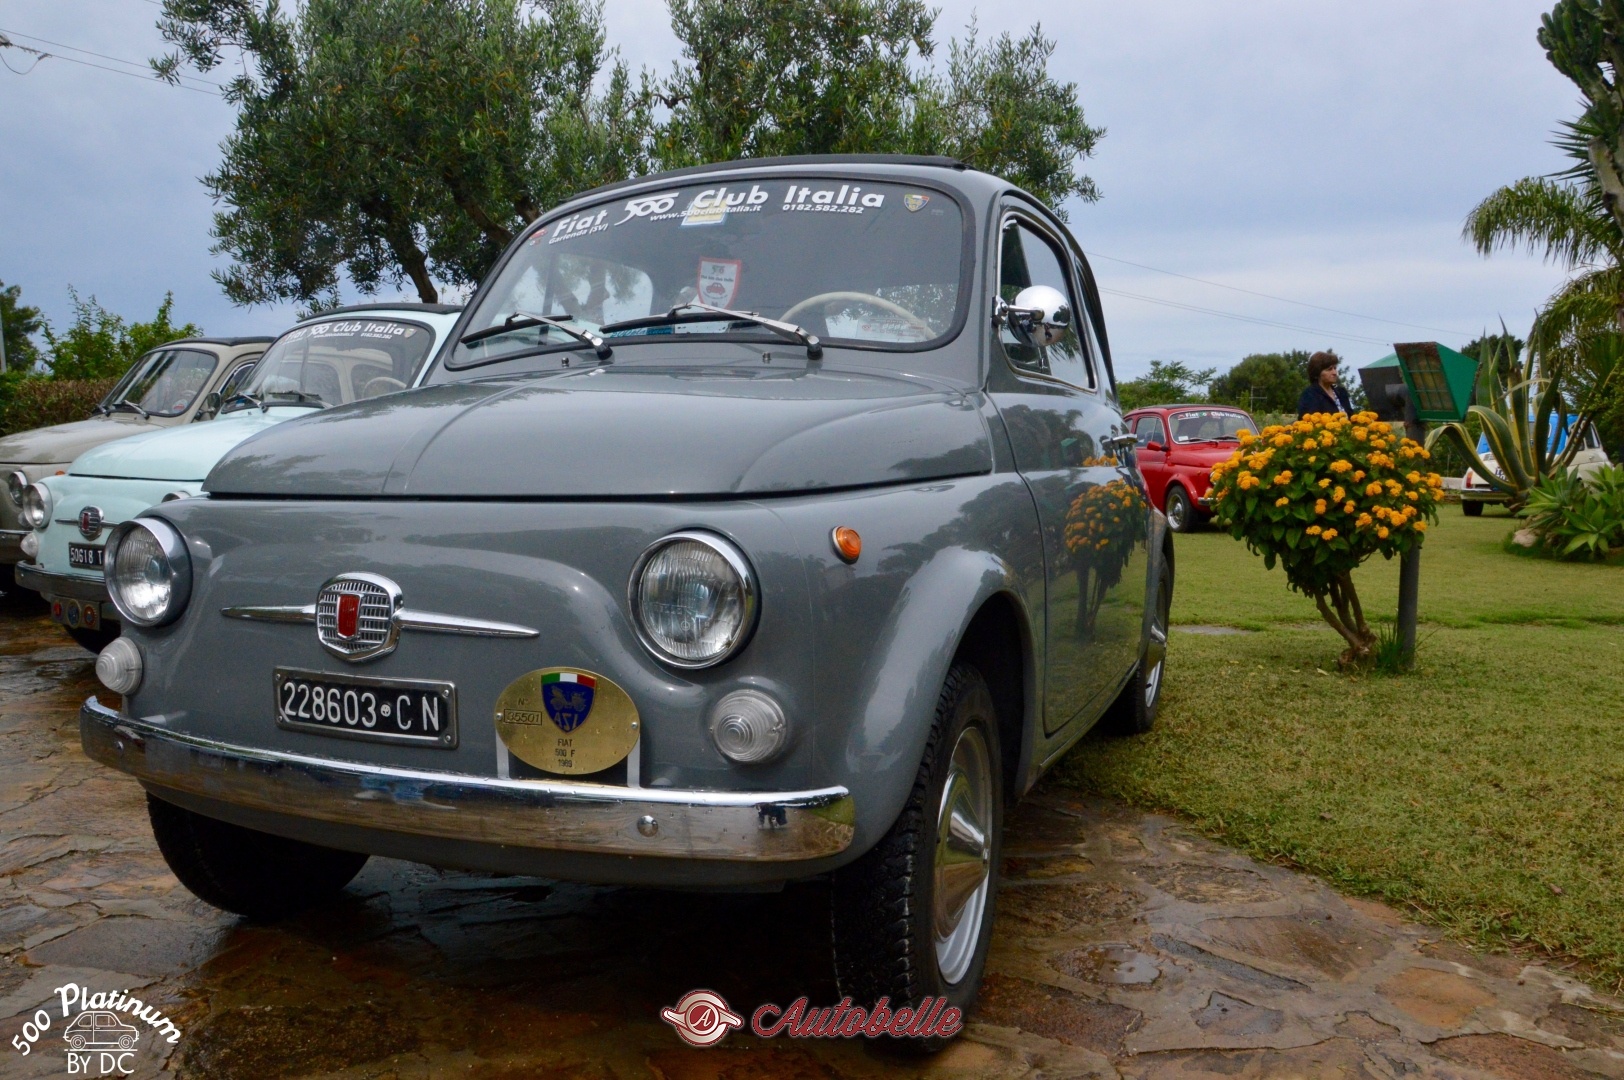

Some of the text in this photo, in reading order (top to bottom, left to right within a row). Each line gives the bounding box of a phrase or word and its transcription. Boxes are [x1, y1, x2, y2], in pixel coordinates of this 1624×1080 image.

[552, 185, 885, 238] Fiat 500 Club Italia
[650, 205, 762, 222] www.500clubitalia.it
[782, 204, 864, 214] 0182.582.282
[333, 321, 362, 332] Club
[364, 323, 404, 335] Italia
[283, 682, 377, 728] 228603
[507, 711, 540, 723] 35501
[557, 738, 573, 747] FIAT
